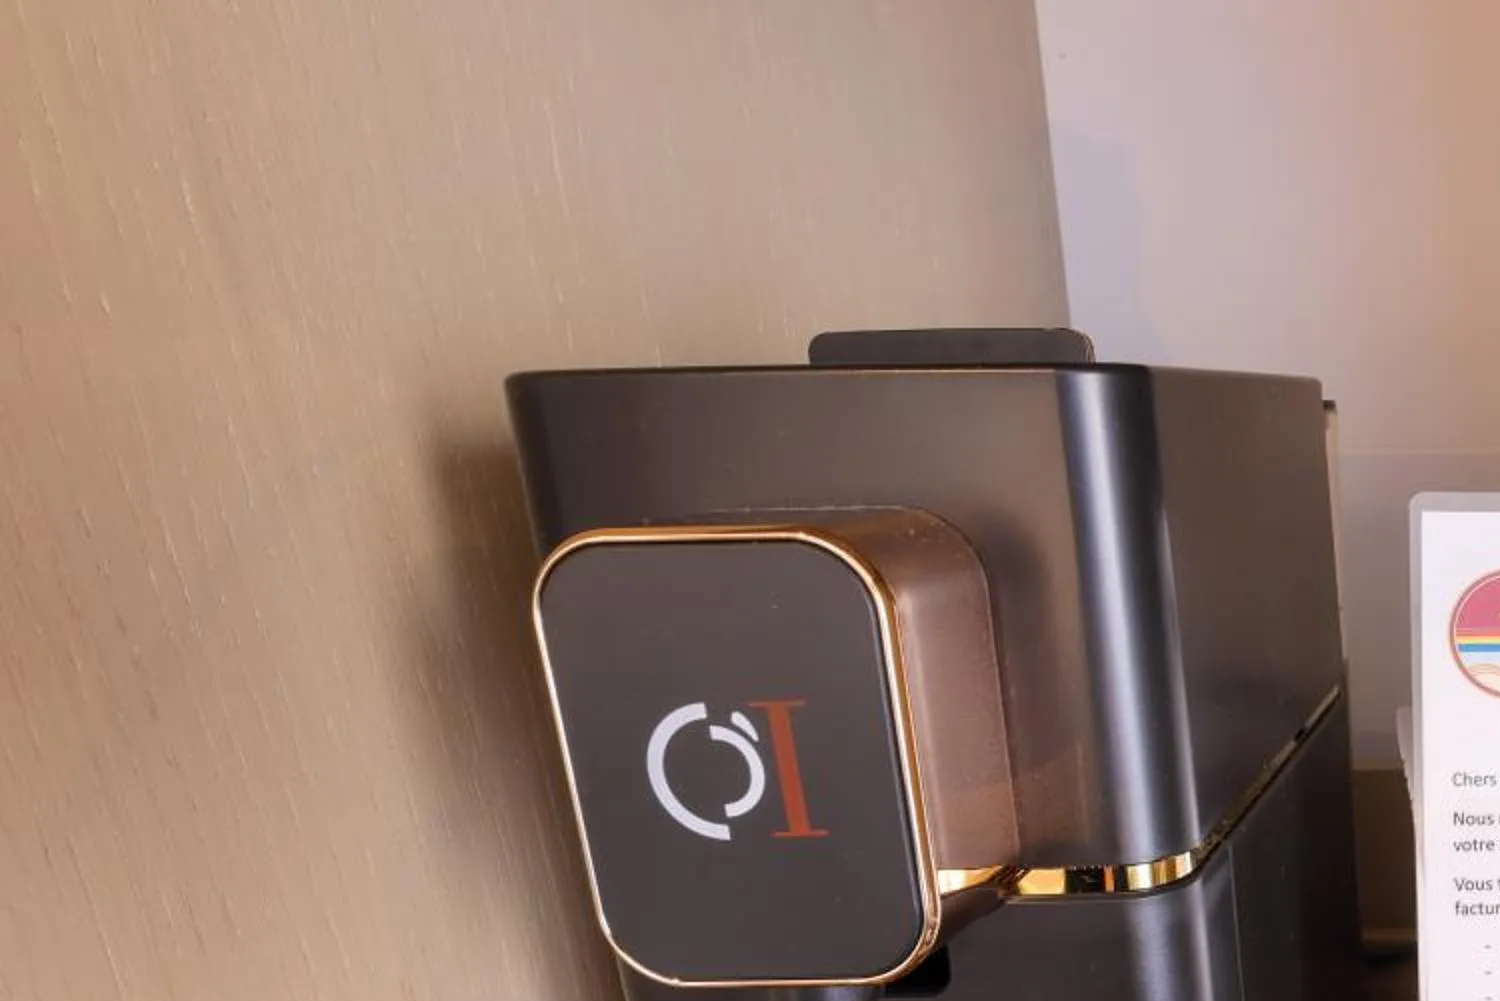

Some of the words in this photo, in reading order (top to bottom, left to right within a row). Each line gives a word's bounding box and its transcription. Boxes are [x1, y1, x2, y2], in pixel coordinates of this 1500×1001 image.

[1451, 771, 1497, 788] Chers
[1452, 811, 1496, 827] Nous
[1453, 839, 1496, 853] votre
[1453, 877, 1494, 892] Vous
